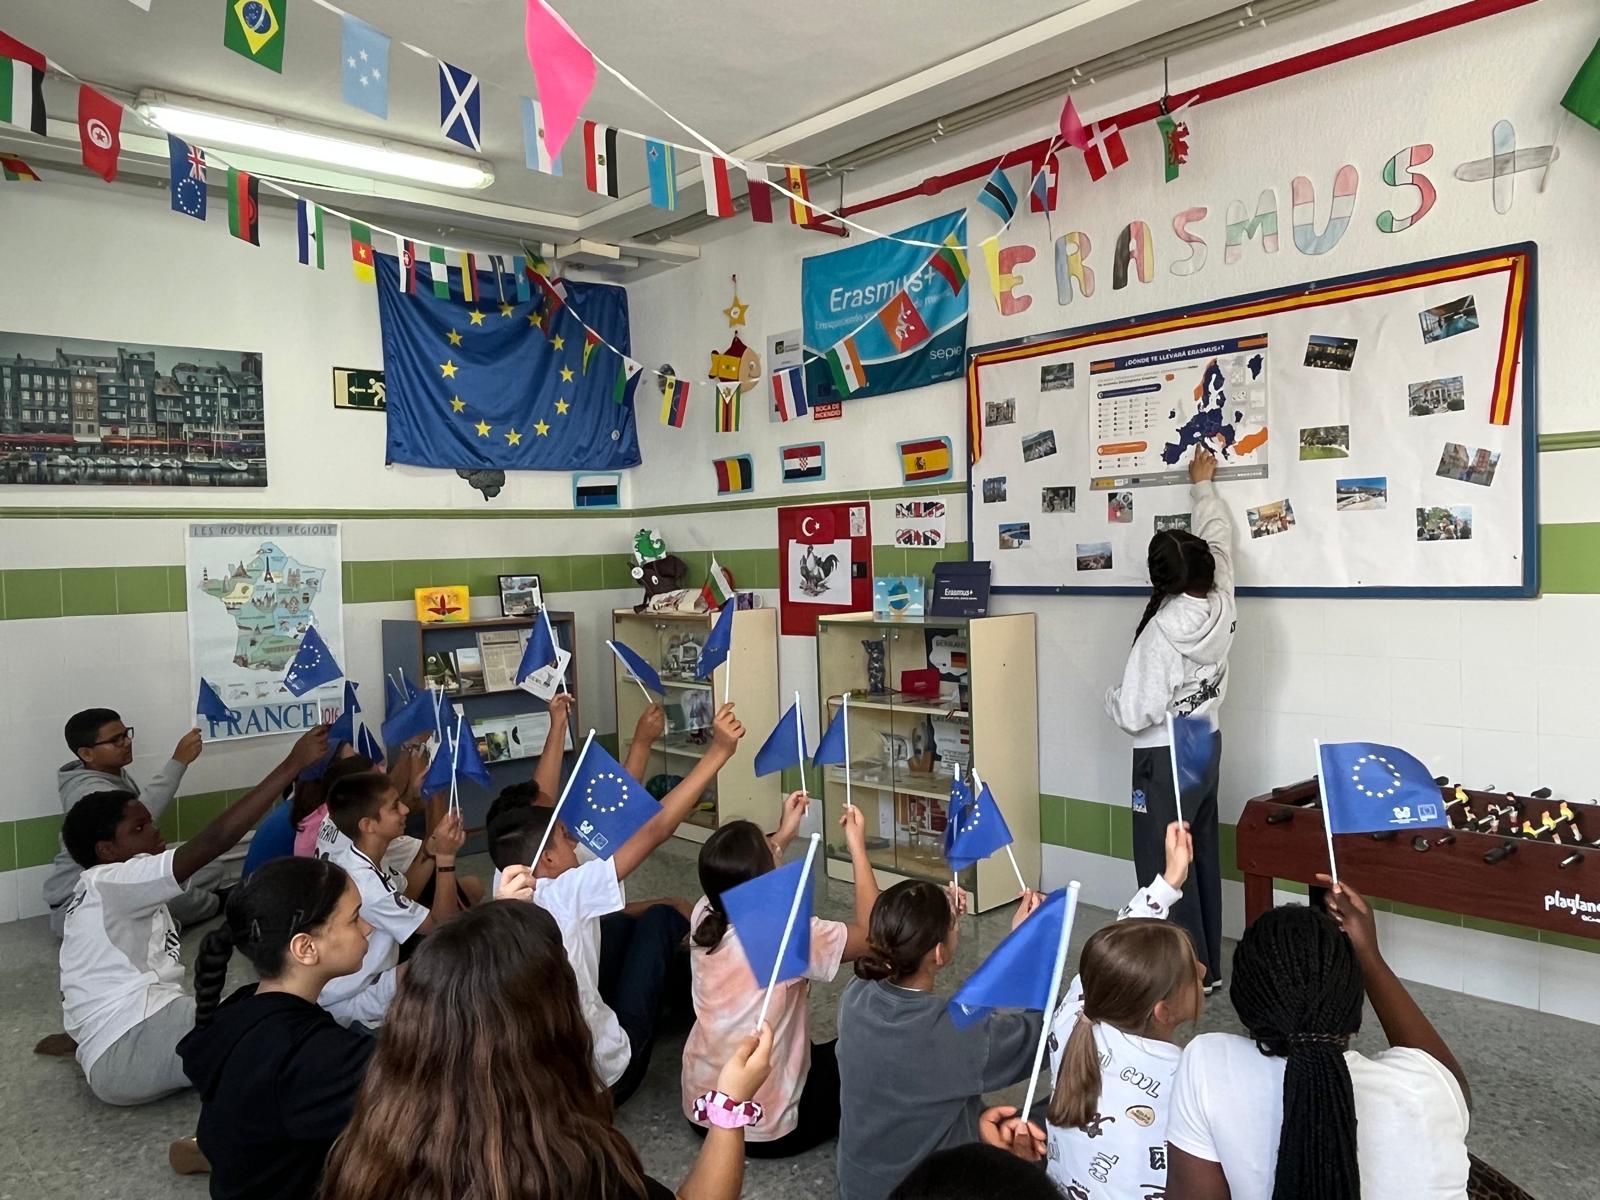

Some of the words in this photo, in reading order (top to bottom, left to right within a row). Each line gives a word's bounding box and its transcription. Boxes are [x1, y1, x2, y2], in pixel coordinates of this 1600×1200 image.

[997, 119, 1560, 316] ERASMUS+
[829, 265, 937, 313] Erasmus+
[1150, 355, 1159, 363] TE
[193, 526, 213, 537] LES
[220, 525, 281, 536] NOUVELLES
[1119, 1066, 1161, 1099] COOL
